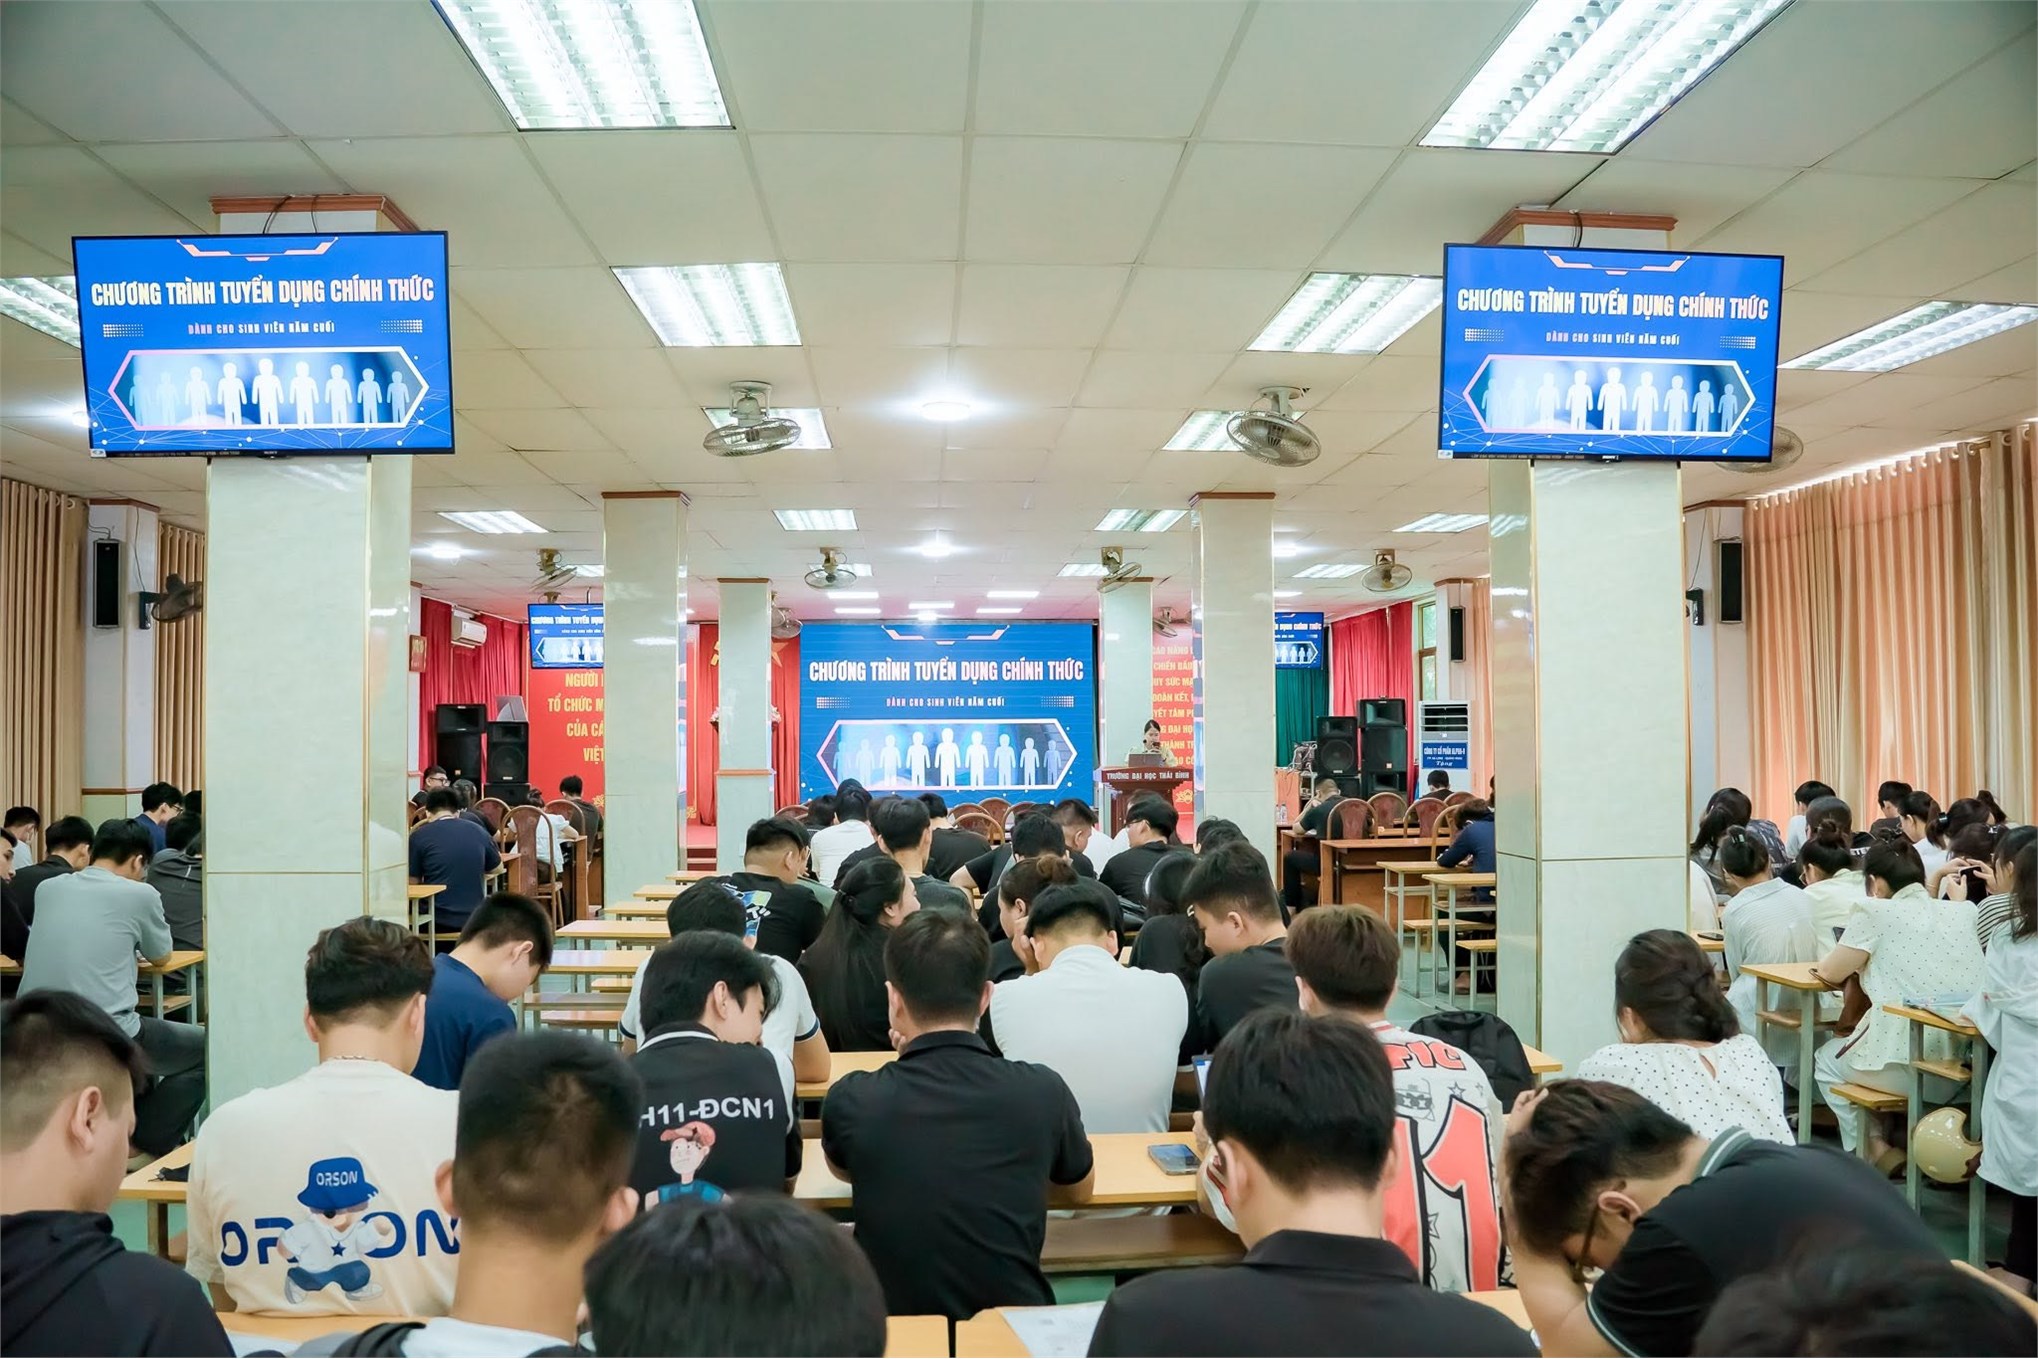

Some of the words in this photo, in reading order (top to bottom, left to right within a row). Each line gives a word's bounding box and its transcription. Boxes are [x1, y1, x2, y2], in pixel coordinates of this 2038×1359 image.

[91, 281, 162, 306] CHƯƠNG
[165, 276, 216, 305] TRÌNH
[220, 274, 274, 304] TUYỂN
[278, 279, 325, 308] DỤNG
[330, 274, 383, 302] CHÍNH
[388, 274, 435, 301] THỨC
[1457, 287, 1525, 312] CHƯƠNG
[1529, 286, 1575, 314] TRÌNH
[1580, 287, 1629, 315] TUYỂN
[1632, 293, 1675, 321] DỤNG
[1679, 292, 1725, 319] CHÍNH
[1729, 294, 1769, 320] THỨC
[216, 324, 234, 334] CHO
[238, 323, 260, 334] SINH
[264, 320, 285, 333] VIÊN
[1572, 332, 1589, 343] CHO
[1592, 333, 1612, 343] SINH
[1616, 332, 1635, 344] VIÊN
[565, 670, 598, 688] NGƯỜI
[809, 660, 866, 682] CHƯƠNG
[870, 657, 910, 681] TRÌNH
[914, 656, 957, 681] TUYỂN
[961, 661, 998, 685] DỤNG
[1002, 657, 1044, 681] CHÍNH
[1047, 657, 1084, 681] THỨC
[548, 693, 561, 712] TỔ
[563, 695, 593, 712] CHỨC
[927, 697, 945, 707] SINH
[566, 719, 588, 737] CỦA
[316, 1170, 358, 1187] ORSON
